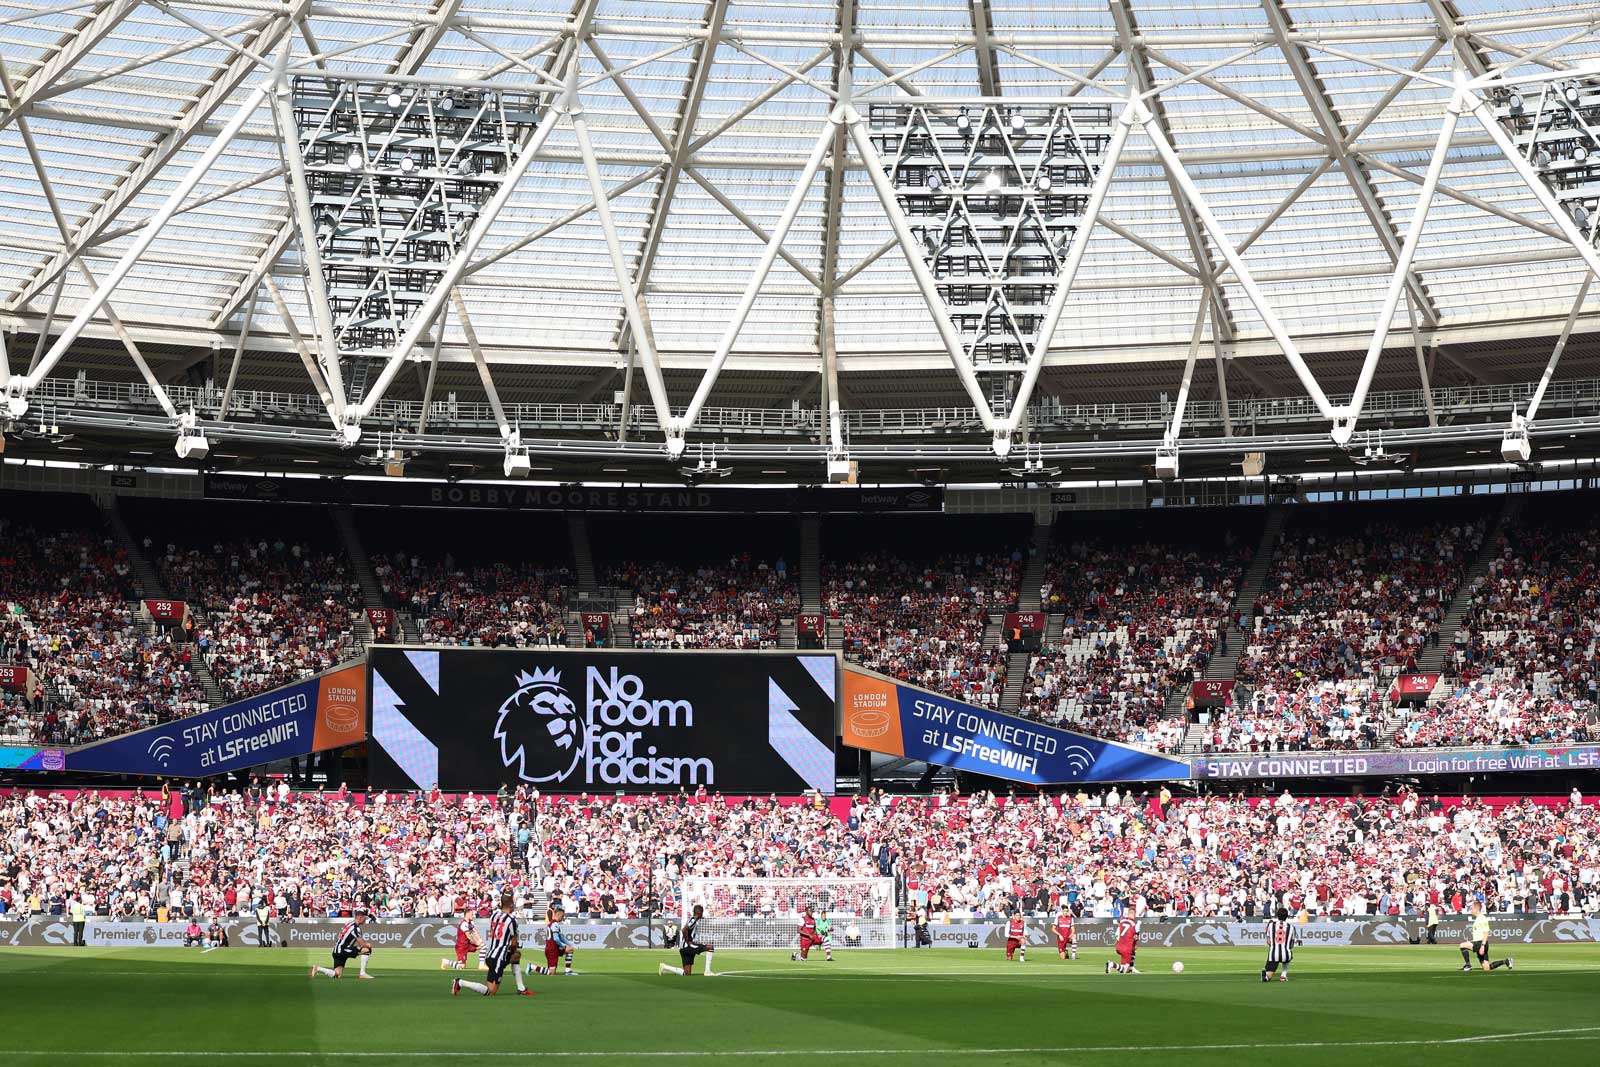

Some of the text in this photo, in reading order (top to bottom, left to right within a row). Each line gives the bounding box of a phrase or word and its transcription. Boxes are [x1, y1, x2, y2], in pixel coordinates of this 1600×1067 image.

[210, 479, 249, 493] betway
[431, 487, 712, 507] BOBBY MOORE STAND
[860, 495, 899, 505] betway
[156, 602, 172, 611] 252
[372, 610, 387, 618] 251
[587, 615, 603, 623] 250
[803, 616, 818, 624] 249
[1018, 614, 1034, 623] 248
[586, 665, 643, 702] No
[1206, 682, 1222, 691] 247
[1411, 676, 1428, 684] 246
[327, 687, 357, 696] LONDON
[327, 694, 357, 703] STADIUM
[853, 692, 887, 701] LONDON
[853, 700, 887, 708] STADIUM
[586, 698, 693, 726] room
[182, 693, 307, 747] STAY CONNECTED
[913, 700, 1058, 756] STAY CONNECTED
[584, 724, 642, 758] for
[923, 729, 940, 747] at
[200, 748, 216, 768] at
[585, 745, 714, 785] racism
[1408, 758, 1448, 773] Login
[1451, 757, 1475, 771] for
[1475, 756, 1507, 770] free
[1509, 755, 1542, 769] WiFi
[1544, 755, 1561, 768] at
[1207, 759, 1368, 777] STAY CONNECTED
[93, 928, 140, 940] Premier
[290, 929, 337, 941] Premier
[362, 932, 402, 944] eague
[933, 929, 978, 944] League
[1077, 930, 1103, 941] mier
[1121, 923, 1131, 937] 7
[1275, 929, 1287, 945] 8
[1300, 928, 1343, 942] League
